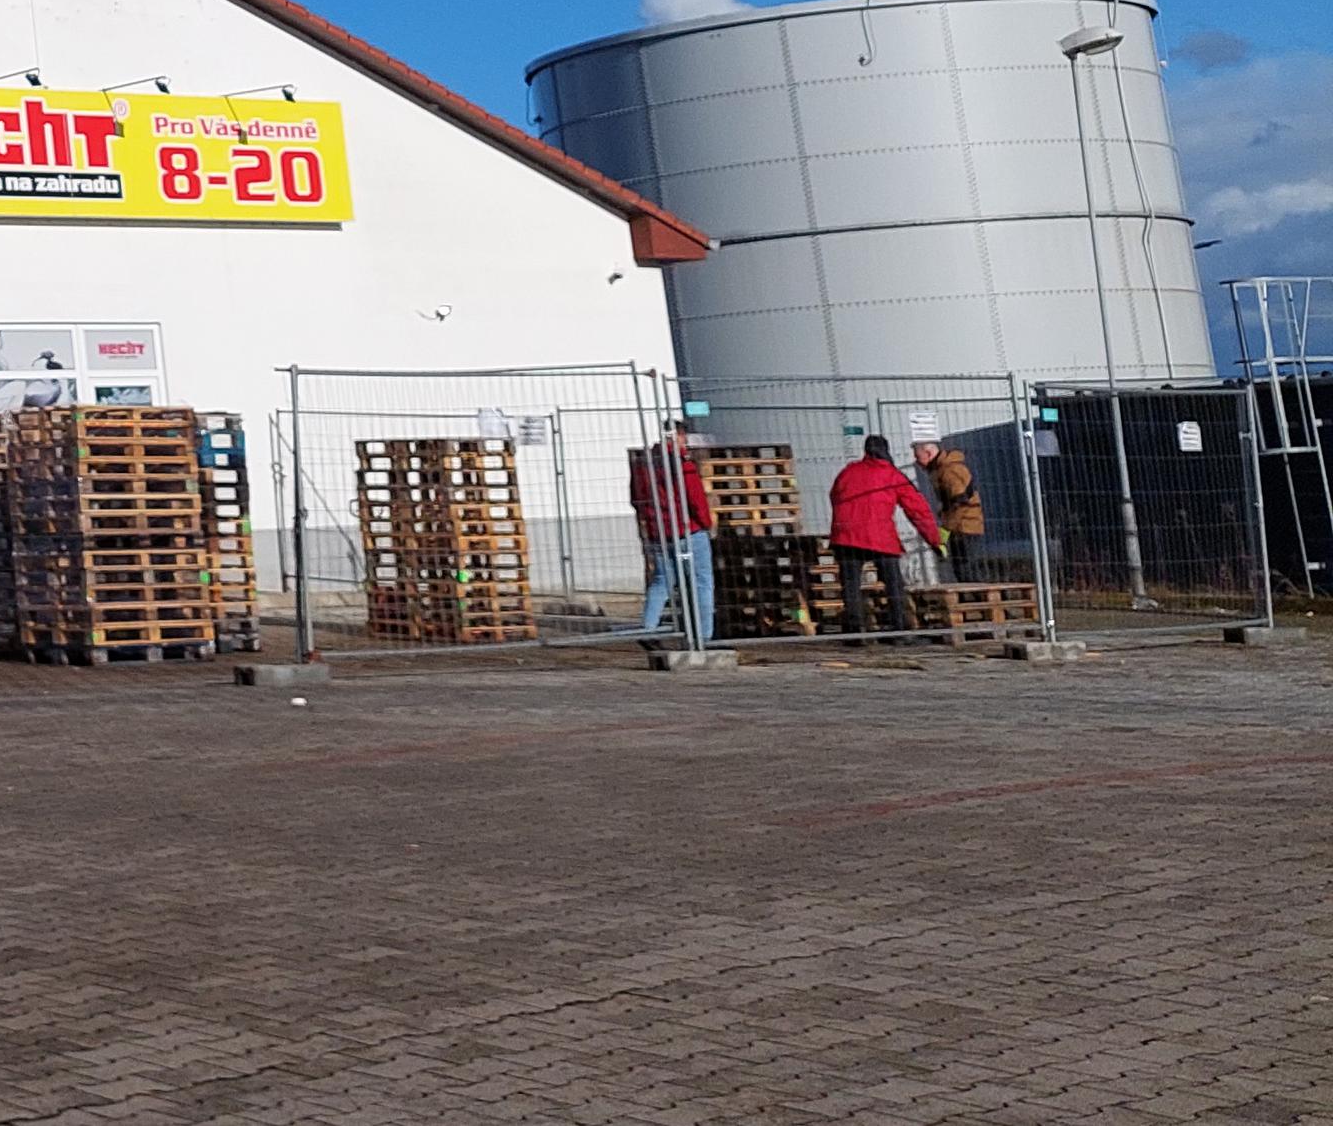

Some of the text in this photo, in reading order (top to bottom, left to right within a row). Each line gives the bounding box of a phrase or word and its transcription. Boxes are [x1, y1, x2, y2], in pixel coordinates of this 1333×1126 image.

[154, 116, 317, 139] Pro Vás denně
[6, 176, 33, 191] na
[35, 175, 120, 194] zahradu
[159, 146, 322, 202] 8-20
